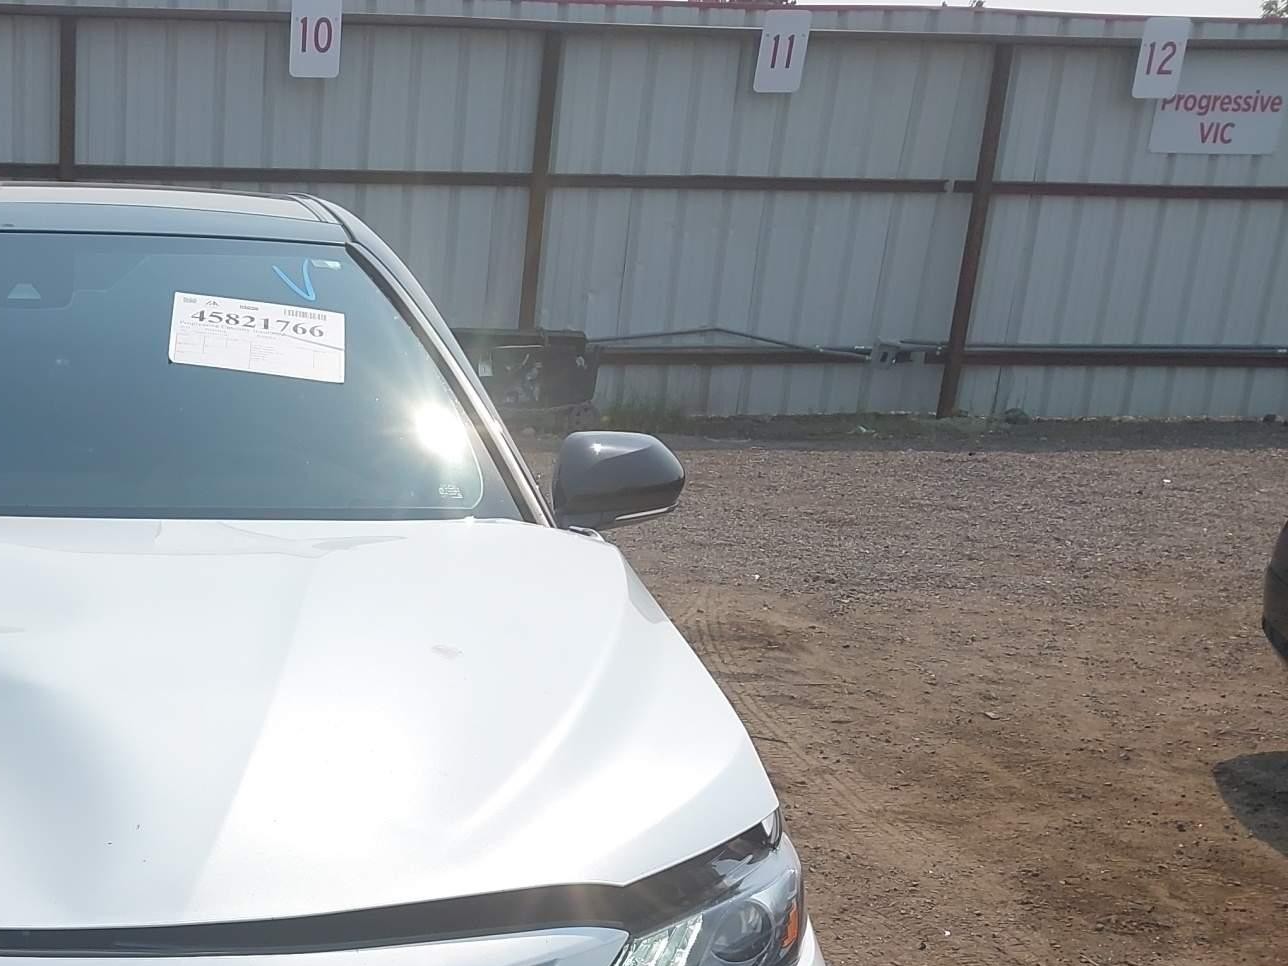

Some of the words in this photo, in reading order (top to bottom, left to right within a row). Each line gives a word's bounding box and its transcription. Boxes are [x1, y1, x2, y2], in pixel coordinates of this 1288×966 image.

[300, 17, 333, 53] 10
[771, 34, 795, 69] 11
[1145, 41, 1177, 76] 12
[1199, 122, 1235, 145] VIC
[191, 310, 325, 338] 45821766
